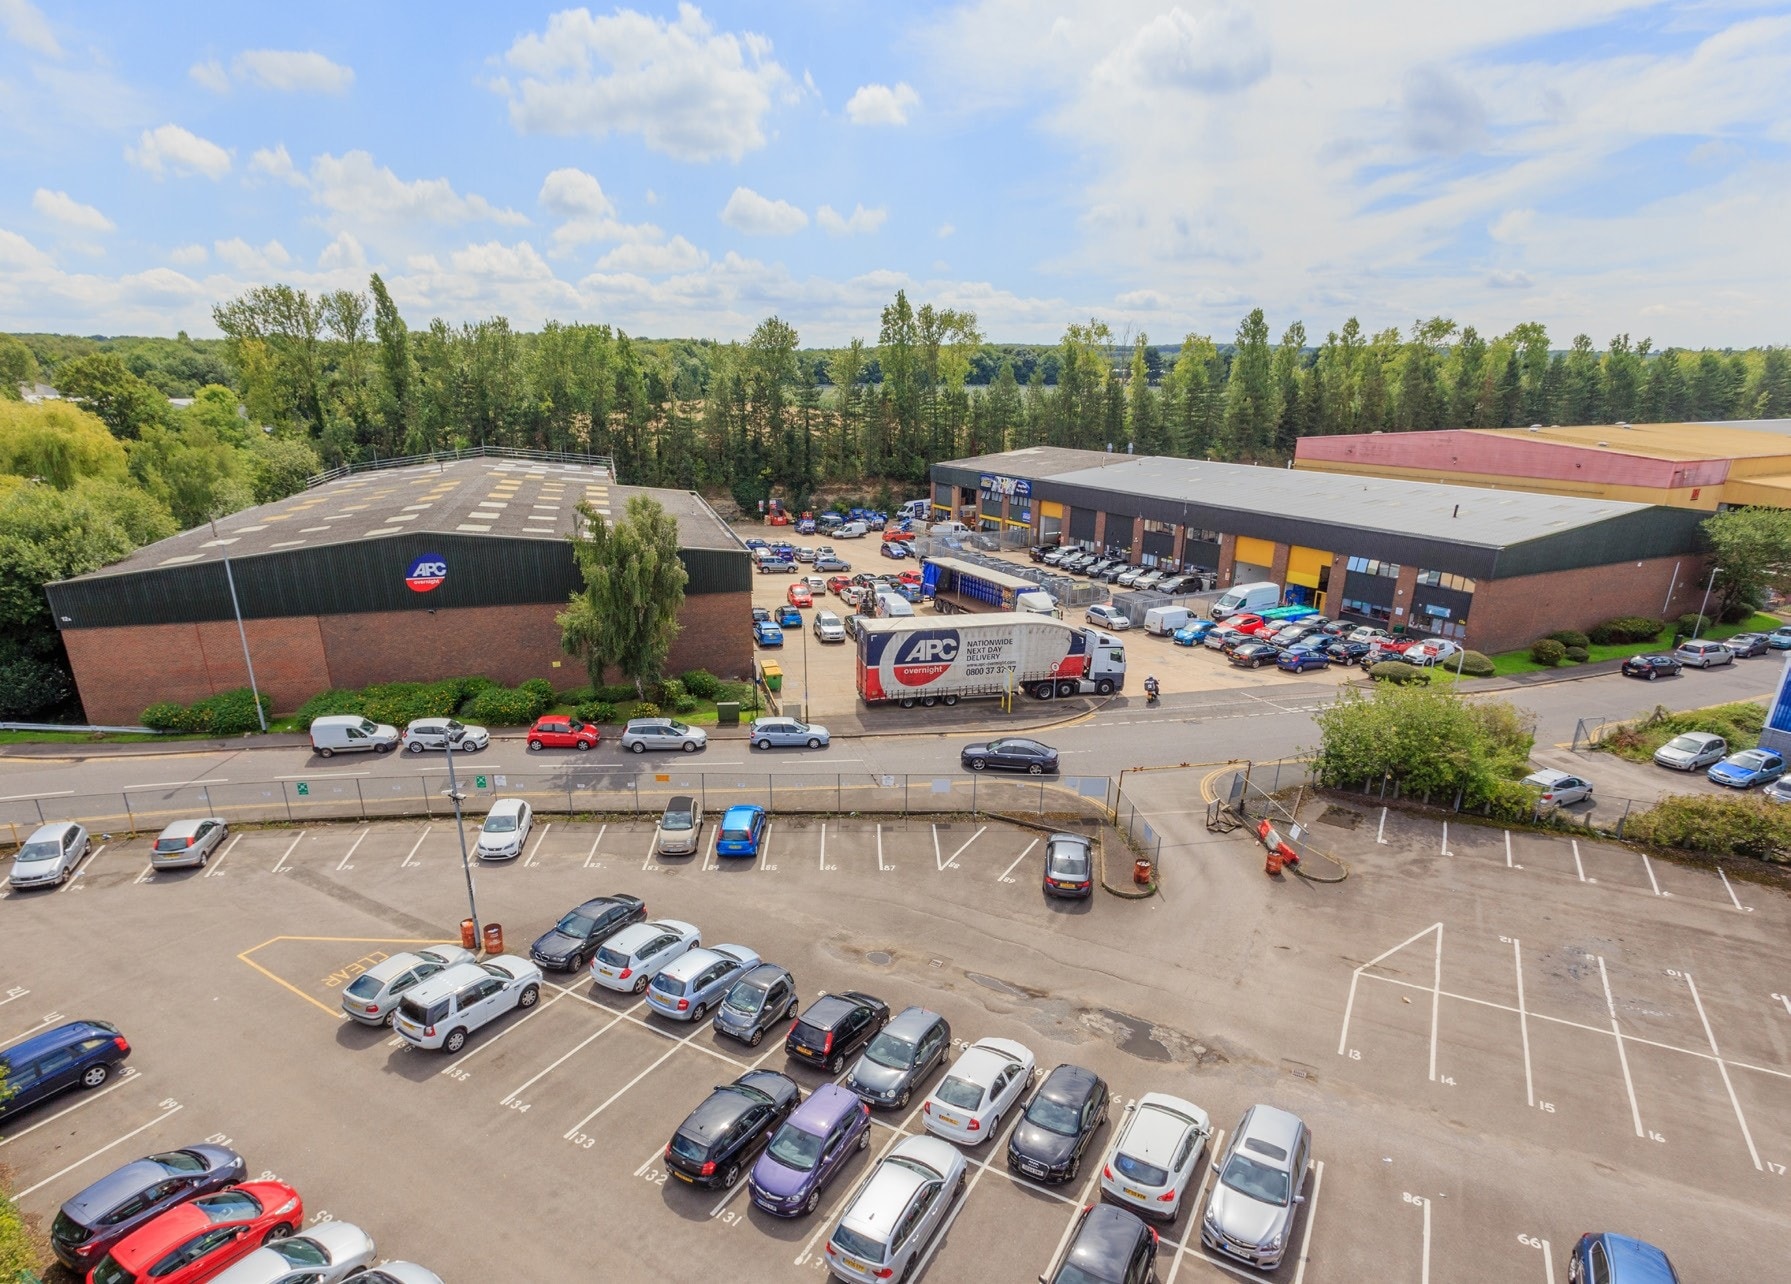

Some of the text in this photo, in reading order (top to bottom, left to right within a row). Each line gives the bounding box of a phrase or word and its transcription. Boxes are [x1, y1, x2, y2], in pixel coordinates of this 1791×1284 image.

[412, 562, 447, 577] APC
[905, 638, 958, 662] APC
[966, 646, 1003, 655] NEXT DAY
[967, 639, 1013, 648] NATIONWIDE
[966, 653, 1001, 662] DELIVERY
[903, 665, 944, 675] overnight
[966, 667, 985, 676] 0800
[985, 666, 995, 675] 37
[1003, 876, 1016, 884] 89
[321, 951, 390, 987] CLEAR
[1348, 1048, 1362, 1060] 13
[446, 1067, 471, 1081] 135
[1440, 1074, 1457, 1086] 14
[505, 1097, 532, 1113] 134
[1539, 1100, 1556, 1113] 15
[568, 1131, 596, 1149] 133
[1648, 1129, 1667, 1143] 16
[1766, 1161, 1787, 1176] 17
[639, 1166, 669, 1186] 132
[715, 1208, 743, 1227] 131
